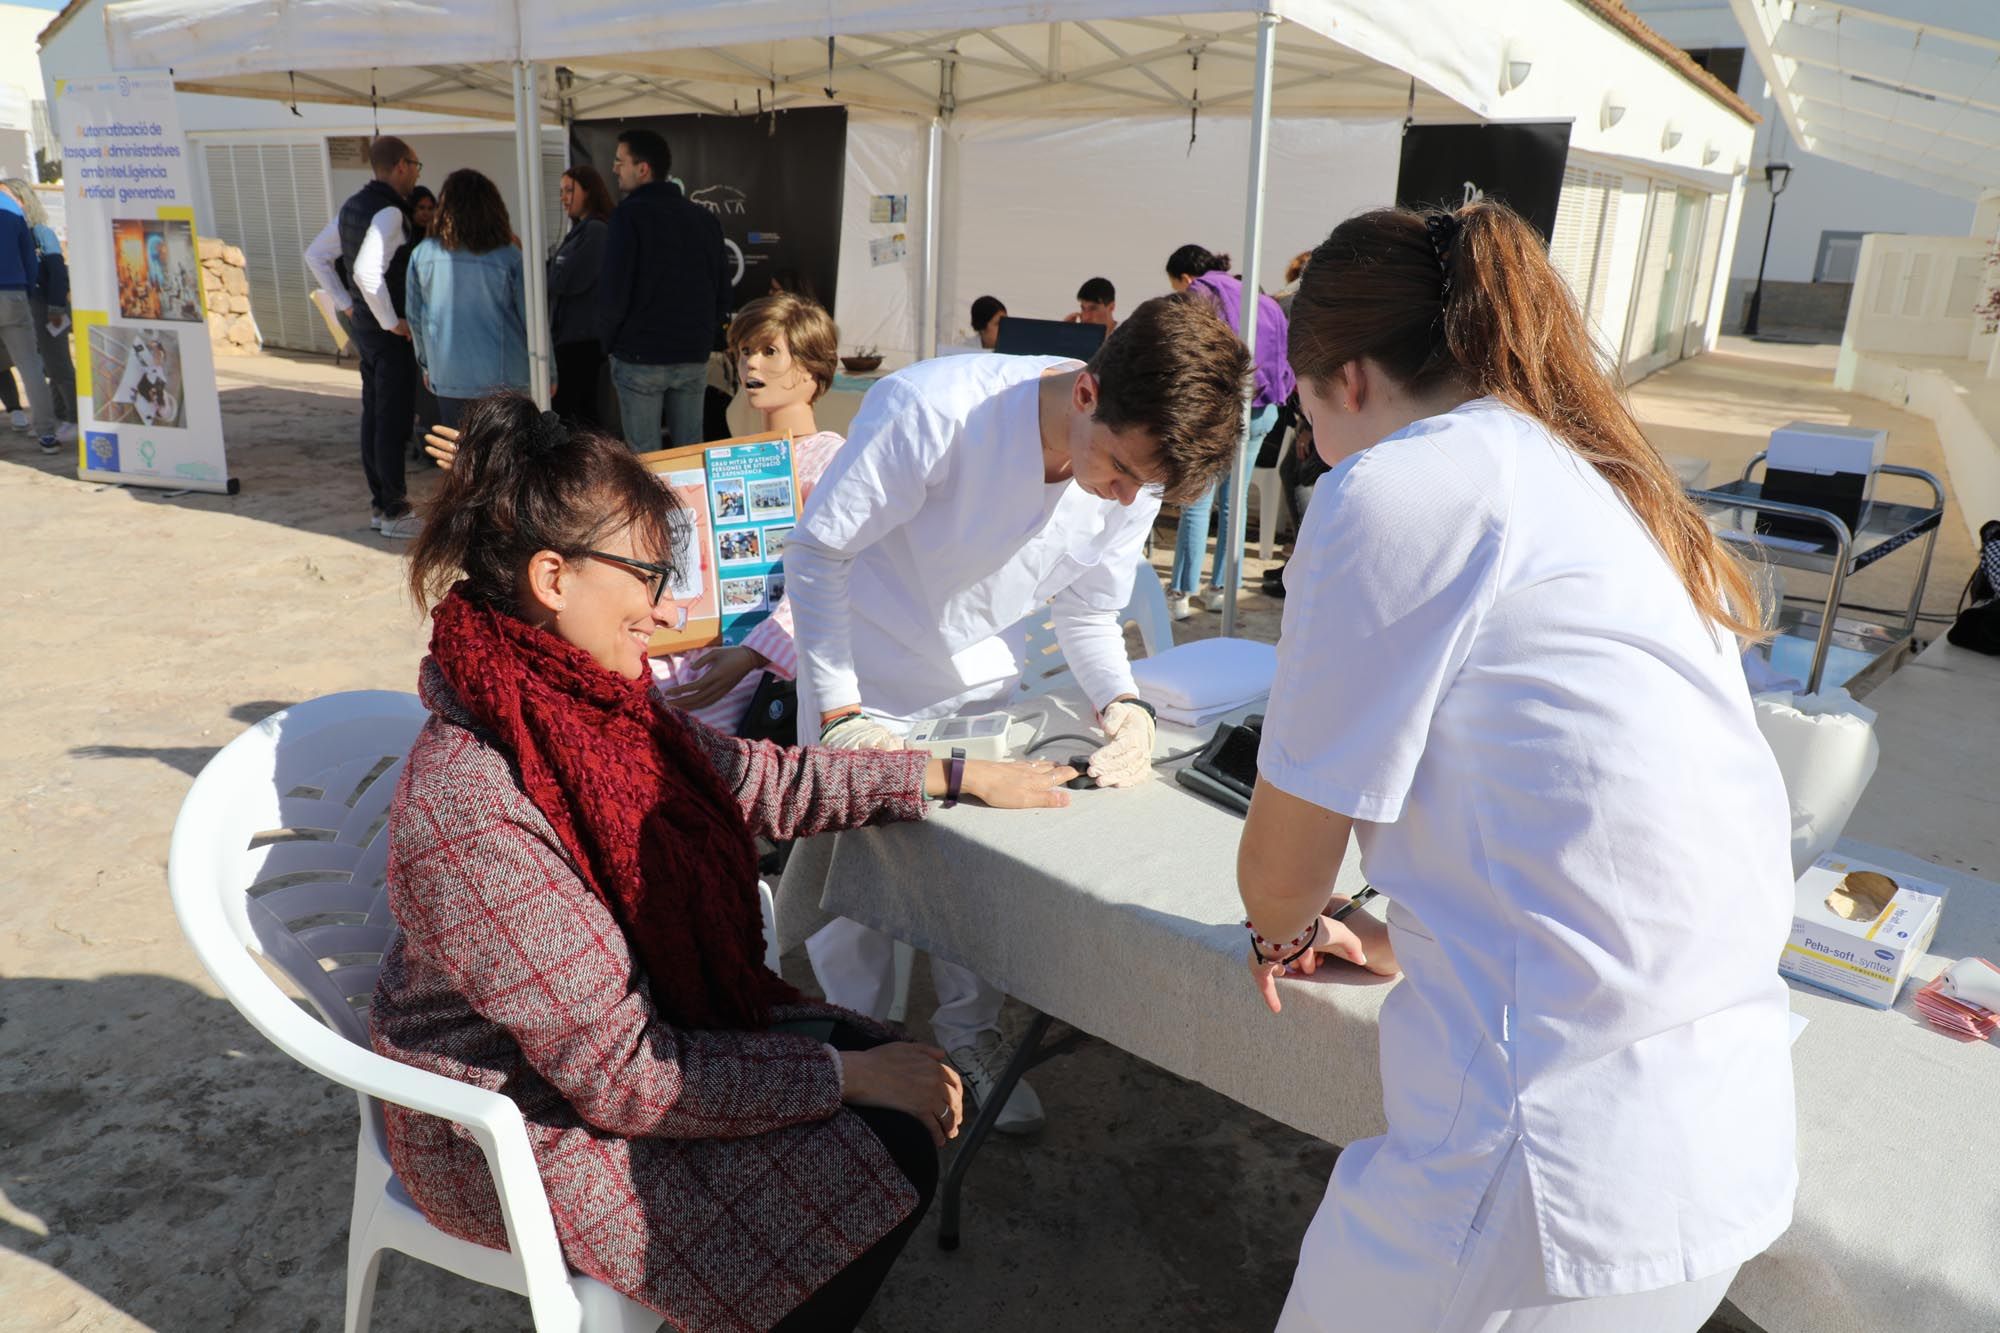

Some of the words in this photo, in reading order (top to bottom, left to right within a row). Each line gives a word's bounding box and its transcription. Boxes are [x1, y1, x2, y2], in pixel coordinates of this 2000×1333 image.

[149, 122, 161, 136] de
[63, 146, 102, 160] tasques
[103, 143, 180, 159] Administratives
[80, 165, 104, 178] amb
[79, 185, 115, 199] Artificial
[119, 186, 175, 203] generativa
[1804, 937, 1855, 963] Peha-soft
[1860, 957, 1892, 975] syntex
